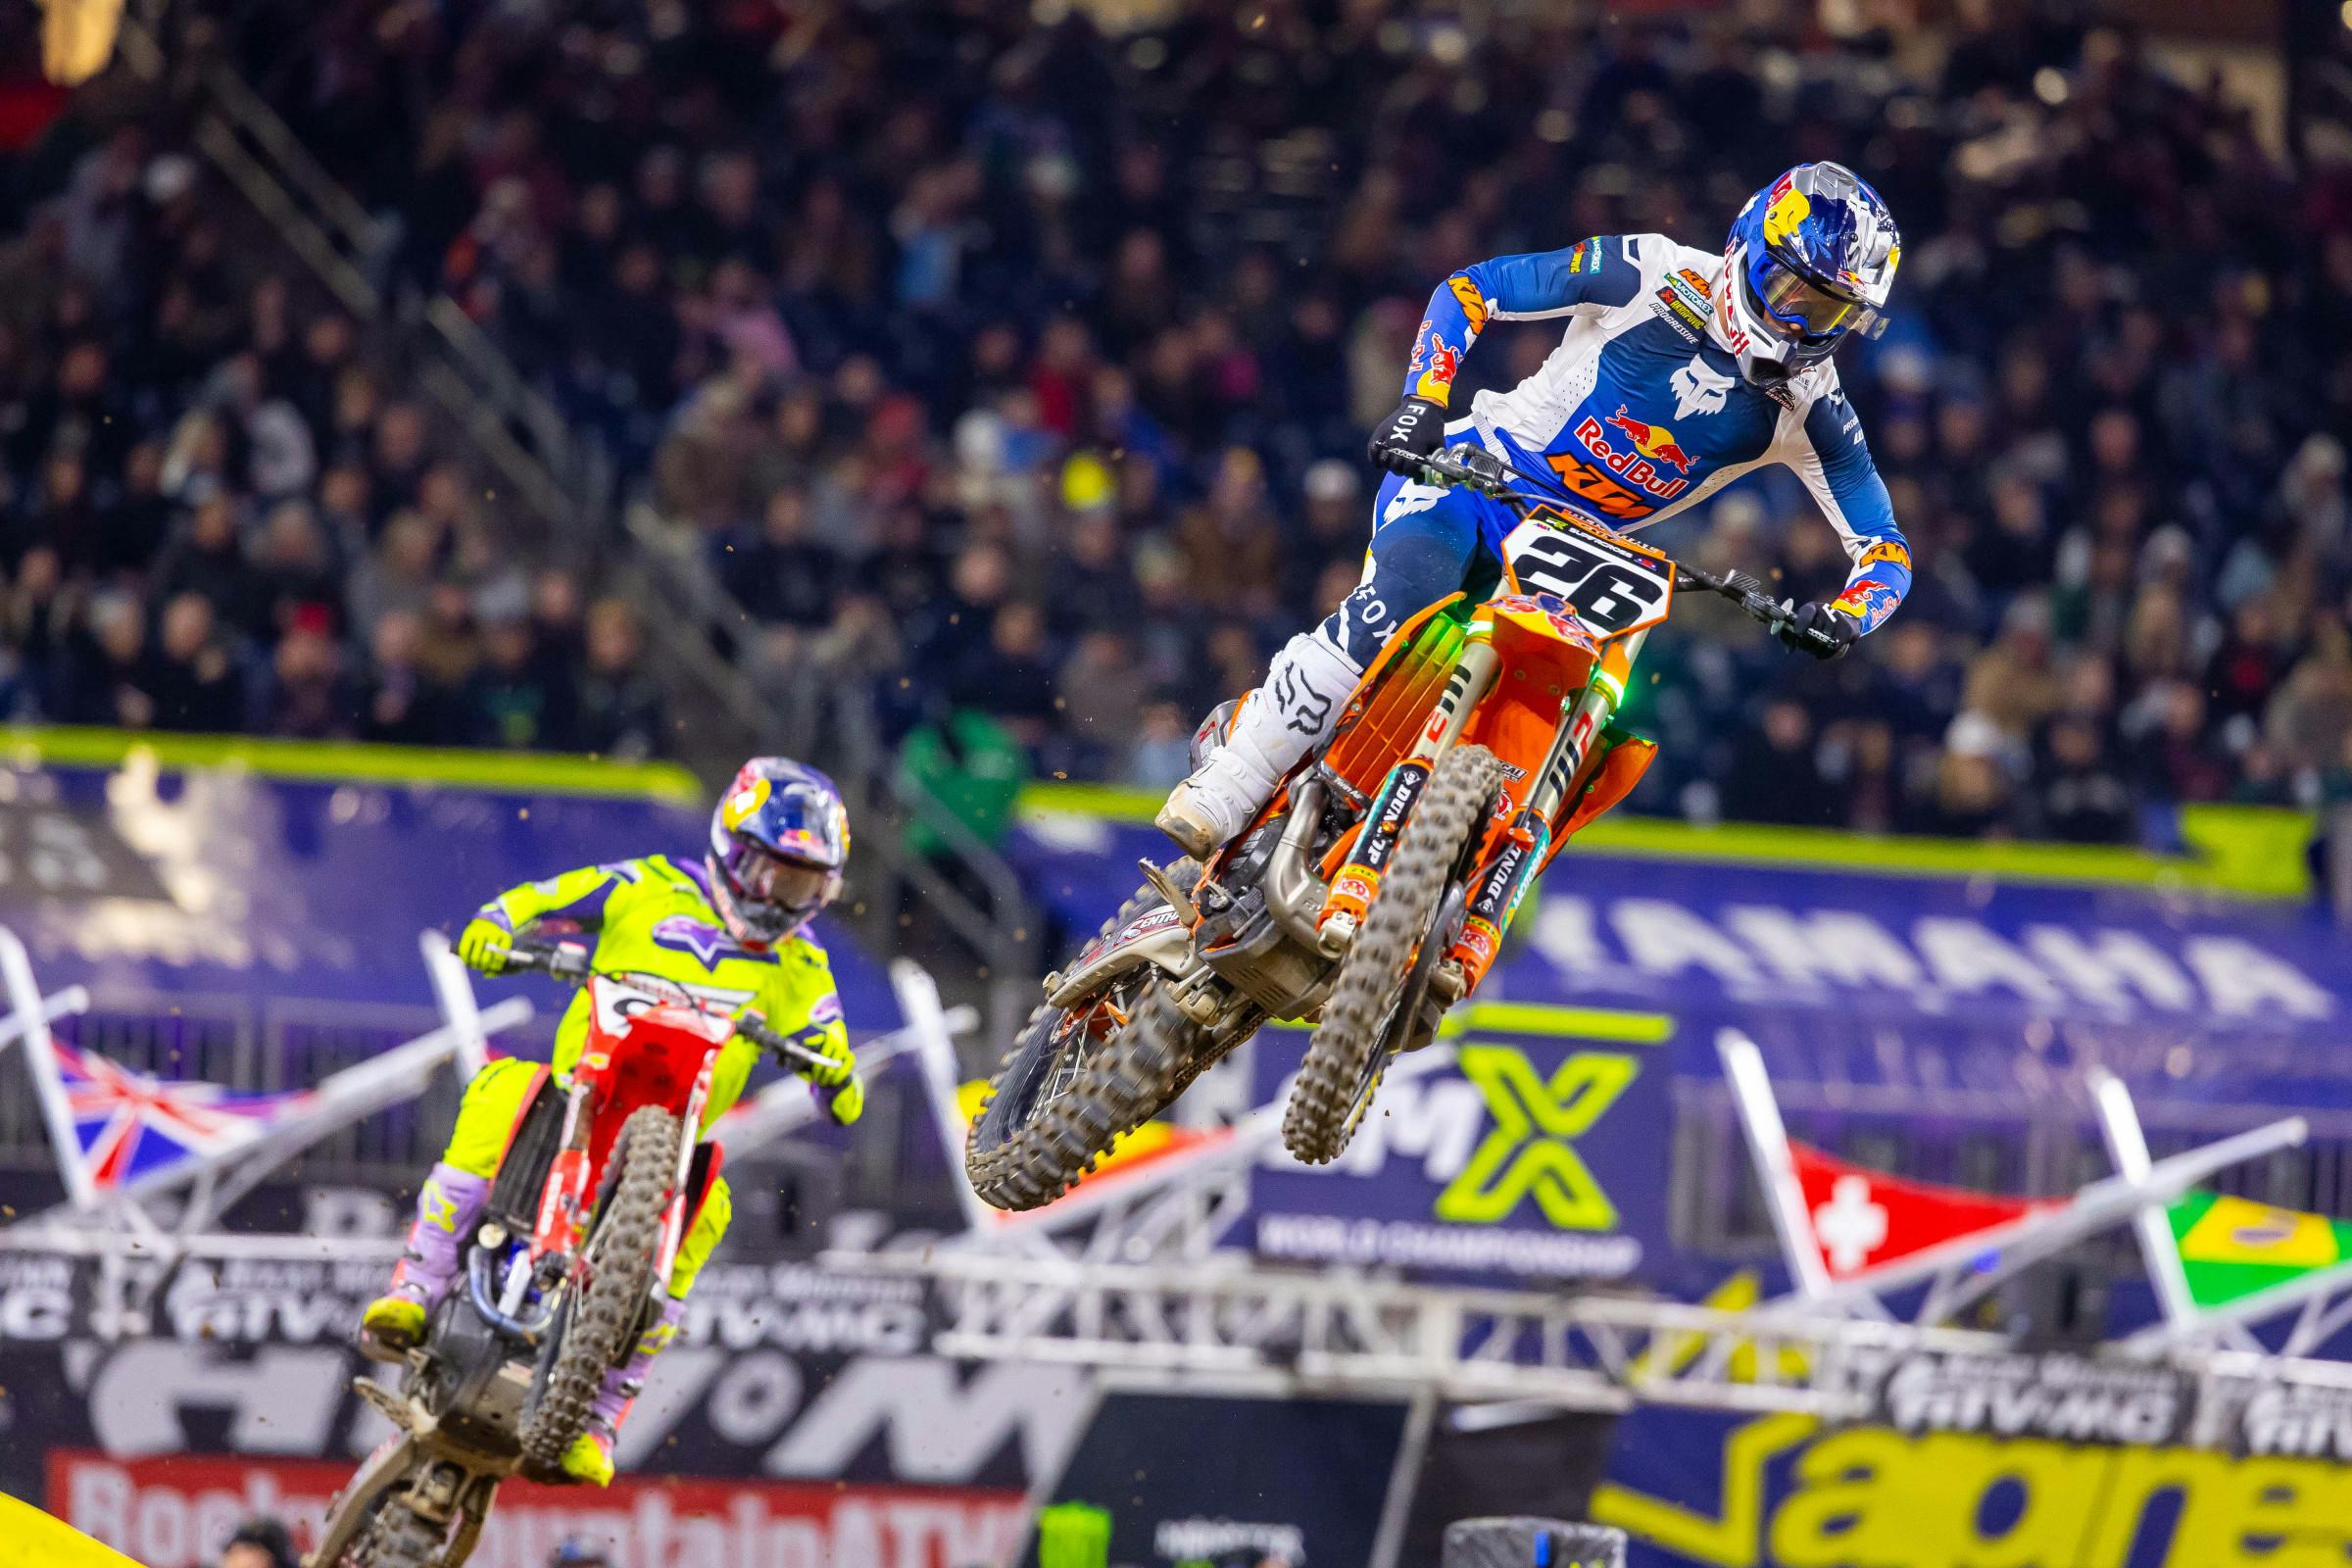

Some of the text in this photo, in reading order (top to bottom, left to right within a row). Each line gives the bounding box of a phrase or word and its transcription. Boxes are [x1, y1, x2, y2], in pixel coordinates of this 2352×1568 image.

[1675, 281, 1712, 315] MOTOREX
[1648, 302, 1698, 345] PROGRESSIVE
[1390, 404, 1427, 442] FOX
[1573, 415, 1690, 500] Red Bull
[1544, 451, 1657, 519] KTM
[1568, 527, 1634, 559] SUPERCROSS
[1512, 535, 1663, 634] 26
